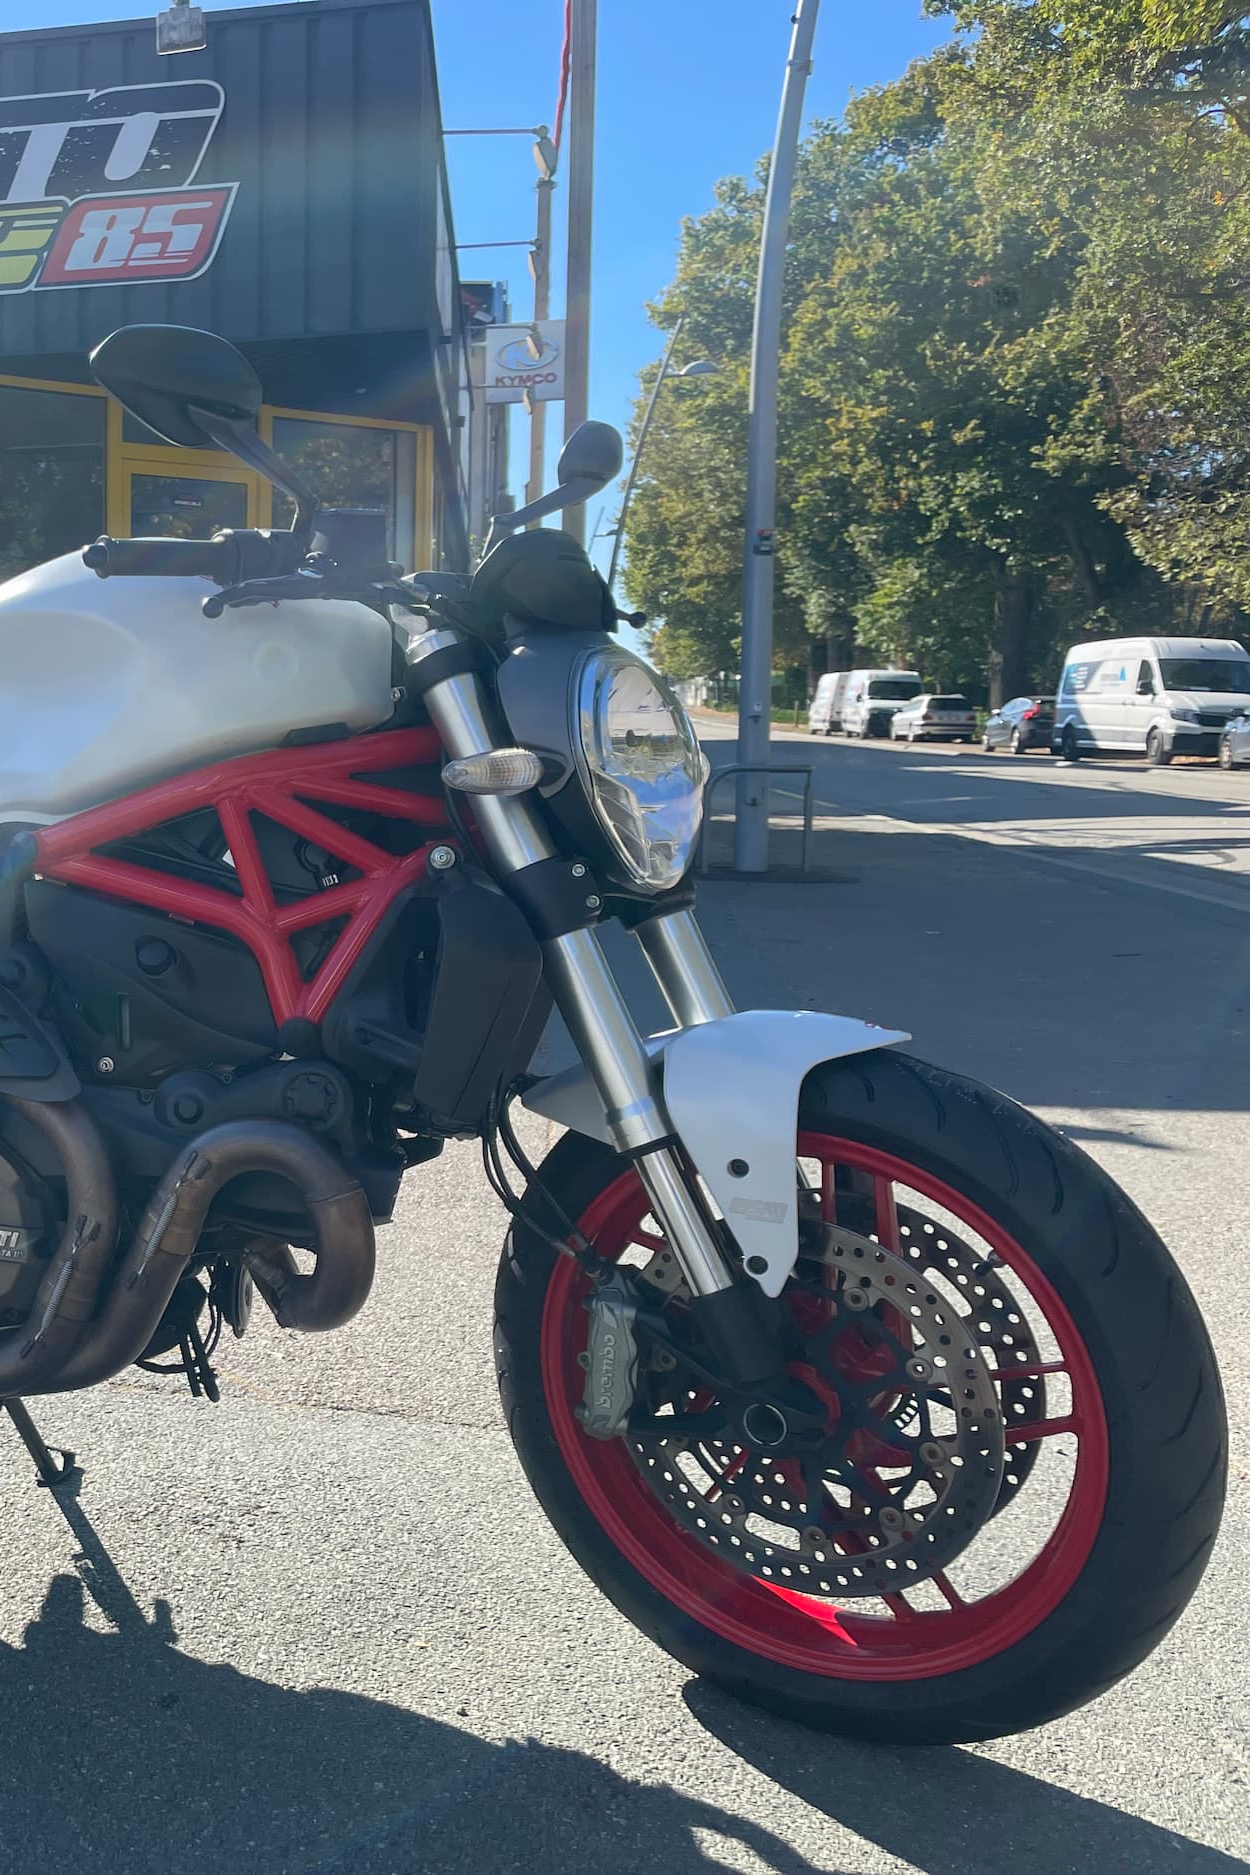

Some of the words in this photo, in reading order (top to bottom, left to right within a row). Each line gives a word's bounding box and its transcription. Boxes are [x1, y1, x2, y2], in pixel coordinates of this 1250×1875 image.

[63, 200, 214, 272] 85
[495, 372, 558, 387] KYMCO
[597, 1334, 616, 1409] brembo
